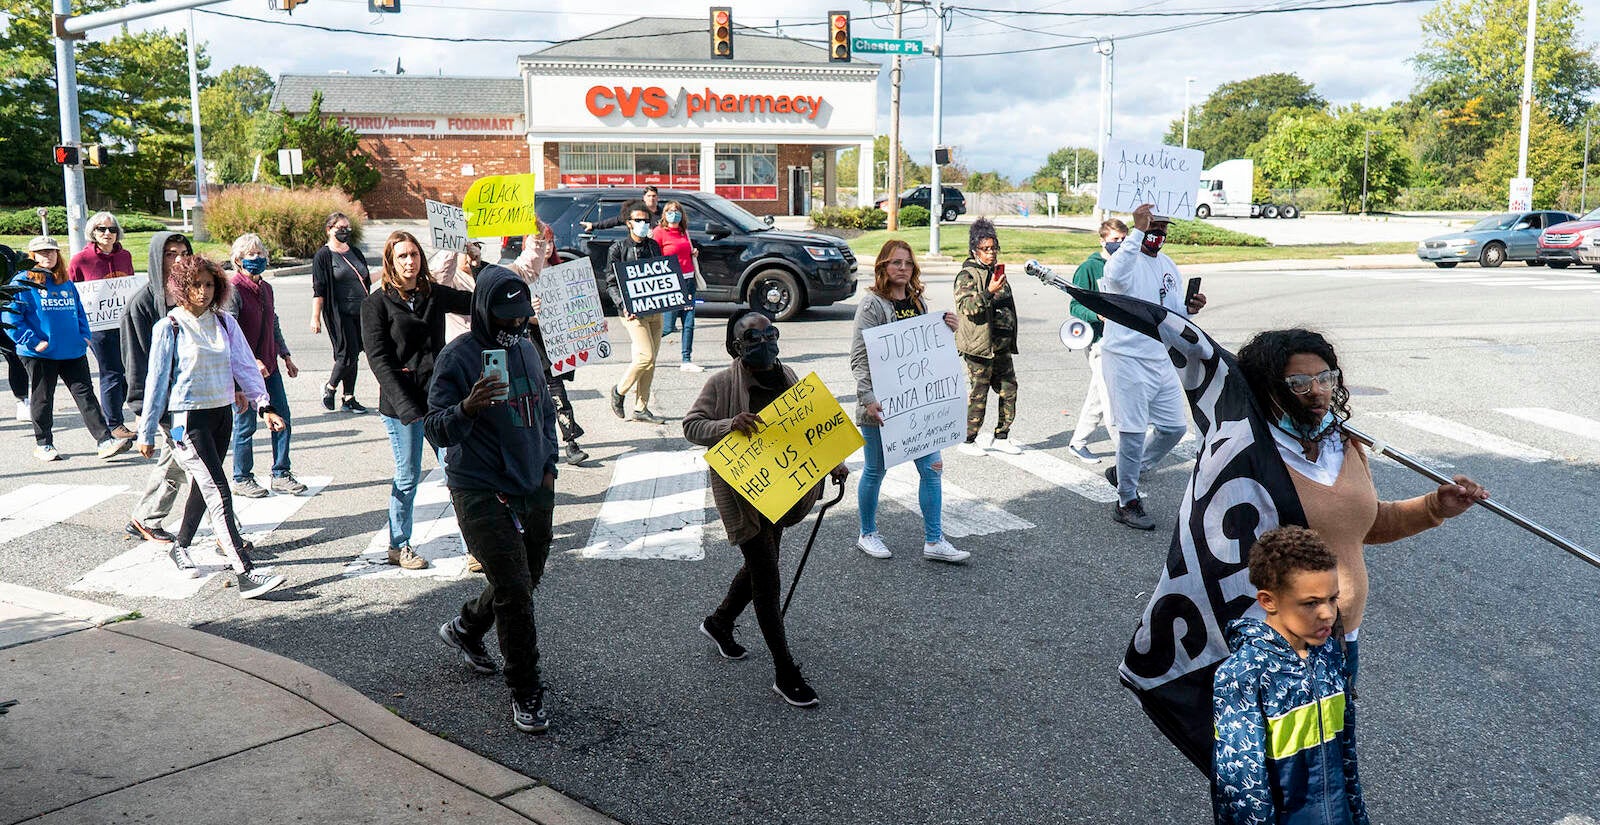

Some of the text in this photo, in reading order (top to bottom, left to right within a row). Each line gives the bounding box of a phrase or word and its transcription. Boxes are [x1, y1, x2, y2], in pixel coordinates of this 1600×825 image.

[855, 40, 919, 52] Chester Pk
[447, 117, 515, 131] FOODMART
[1132, 171, 1156, 193] for
[478, 182, 521, 205] BLACK
[1115, 183, 1193, 217] FANTA
[429, 201, 464, 222] JUSTICE
[443, 216, 457, 230] FOR
[625, 260, 673, 280] BLACK
[78, 277, 137, 294] WE WANT
[535, 287, 563, 304] MORE
[633, 277, 674, 294] LIVES
[632, 292, 686, 314] MATTER
[541, 318, 566, 335] MORE
[545, 333, 566, 347] MORE
[548, 344, 570, 358] MORE
[878, 321, 945, 362] JUSTICE
[897, 357, 935, 386] FOR
[879, 372, 959, 418] FANTA BILITY
[713, 436, 739, 466] IF
[773, 378, 815, 417] LIVES
[777, 400, 815, 433] THEN
[909, 405, 951, 430] 8 yrs old
[885, 419, 957, 453] WE WANT ANSWERS
[903, 441, 930, 457] SHARON
[932, 436, 947, 446] HILL
[739, 411, 845, 501] HELP US PROVE
[788, 457, 820, 491] IT!
